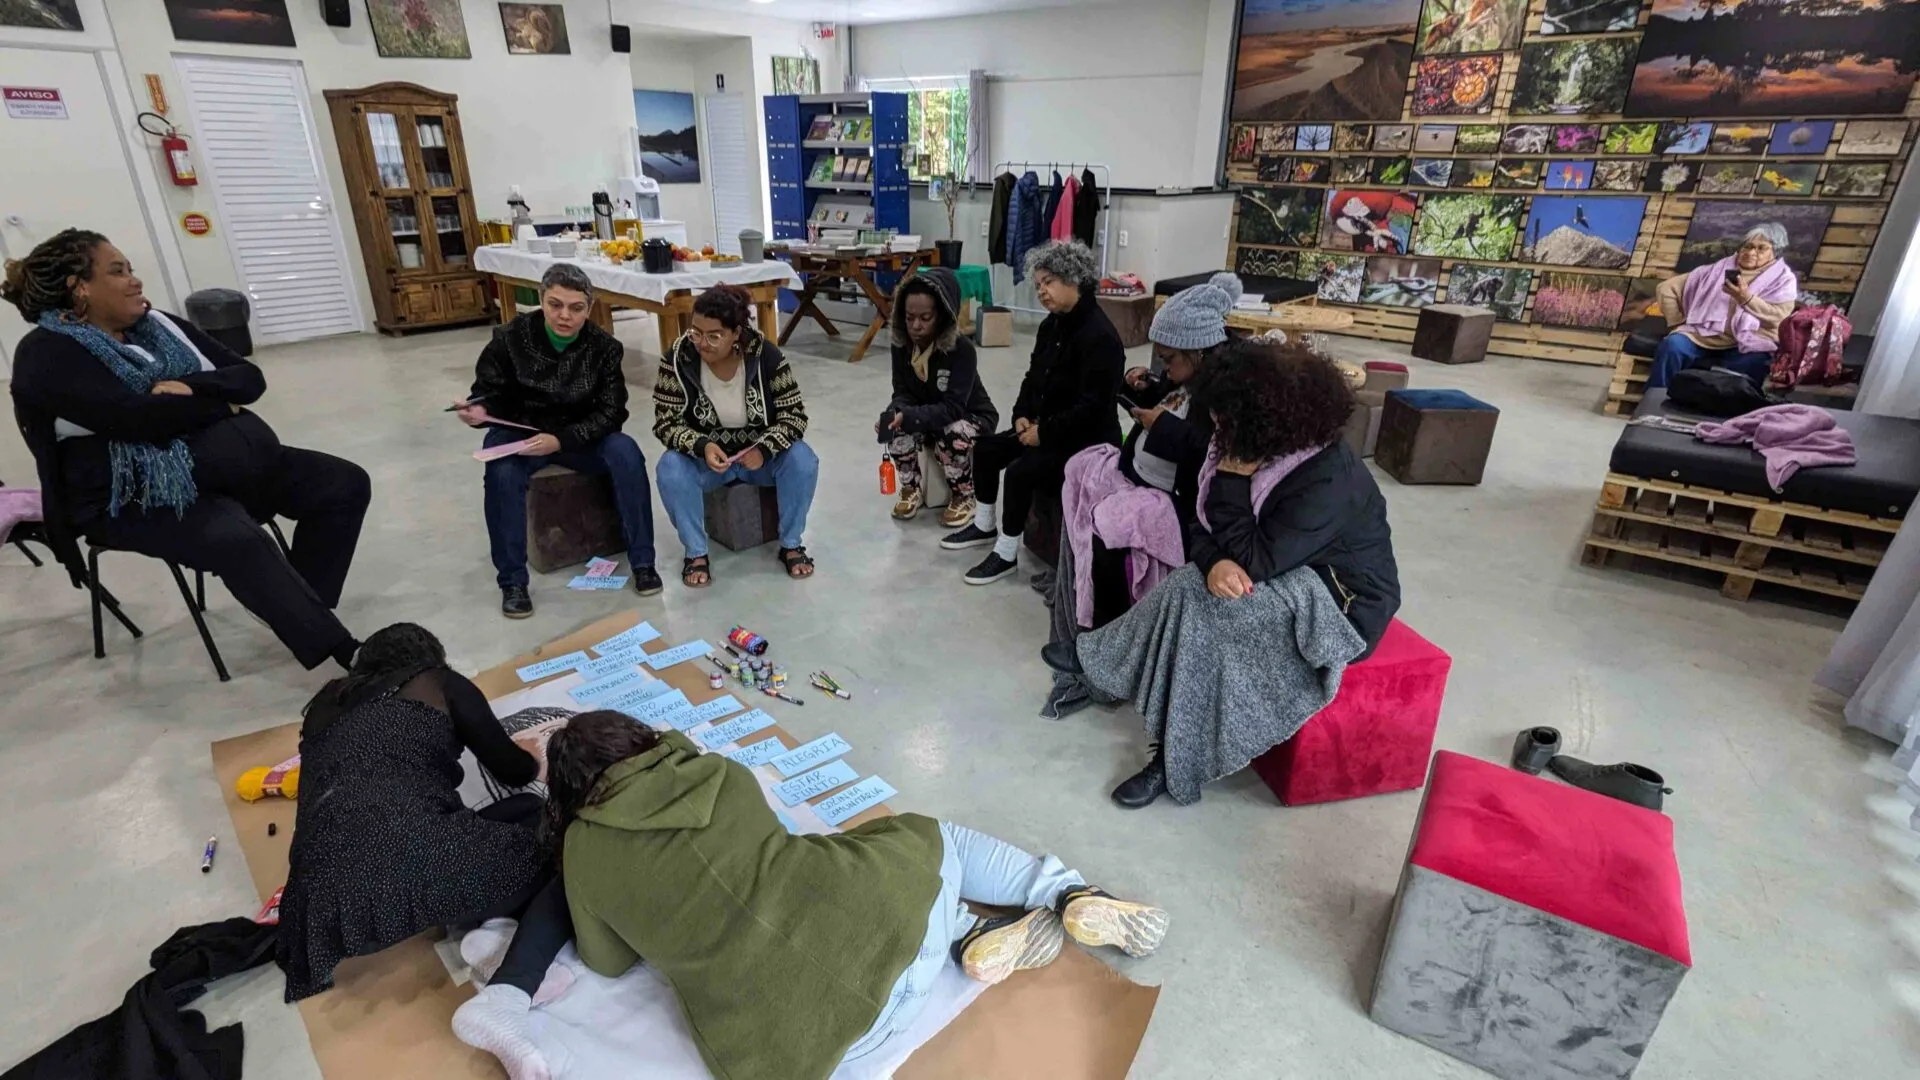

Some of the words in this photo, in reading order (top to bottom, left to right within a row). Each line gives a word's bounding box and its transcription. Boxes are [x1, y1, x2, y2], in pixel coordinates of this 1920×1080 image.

[11, 90, 54, 99] AVISO
[781, 737, 846, 769] ALEGRIA
[780, 770, 820, 793] ESTAR
[791, 776, 840, 801] JUNTO
[820, 786, 862, 810] COZINHA
